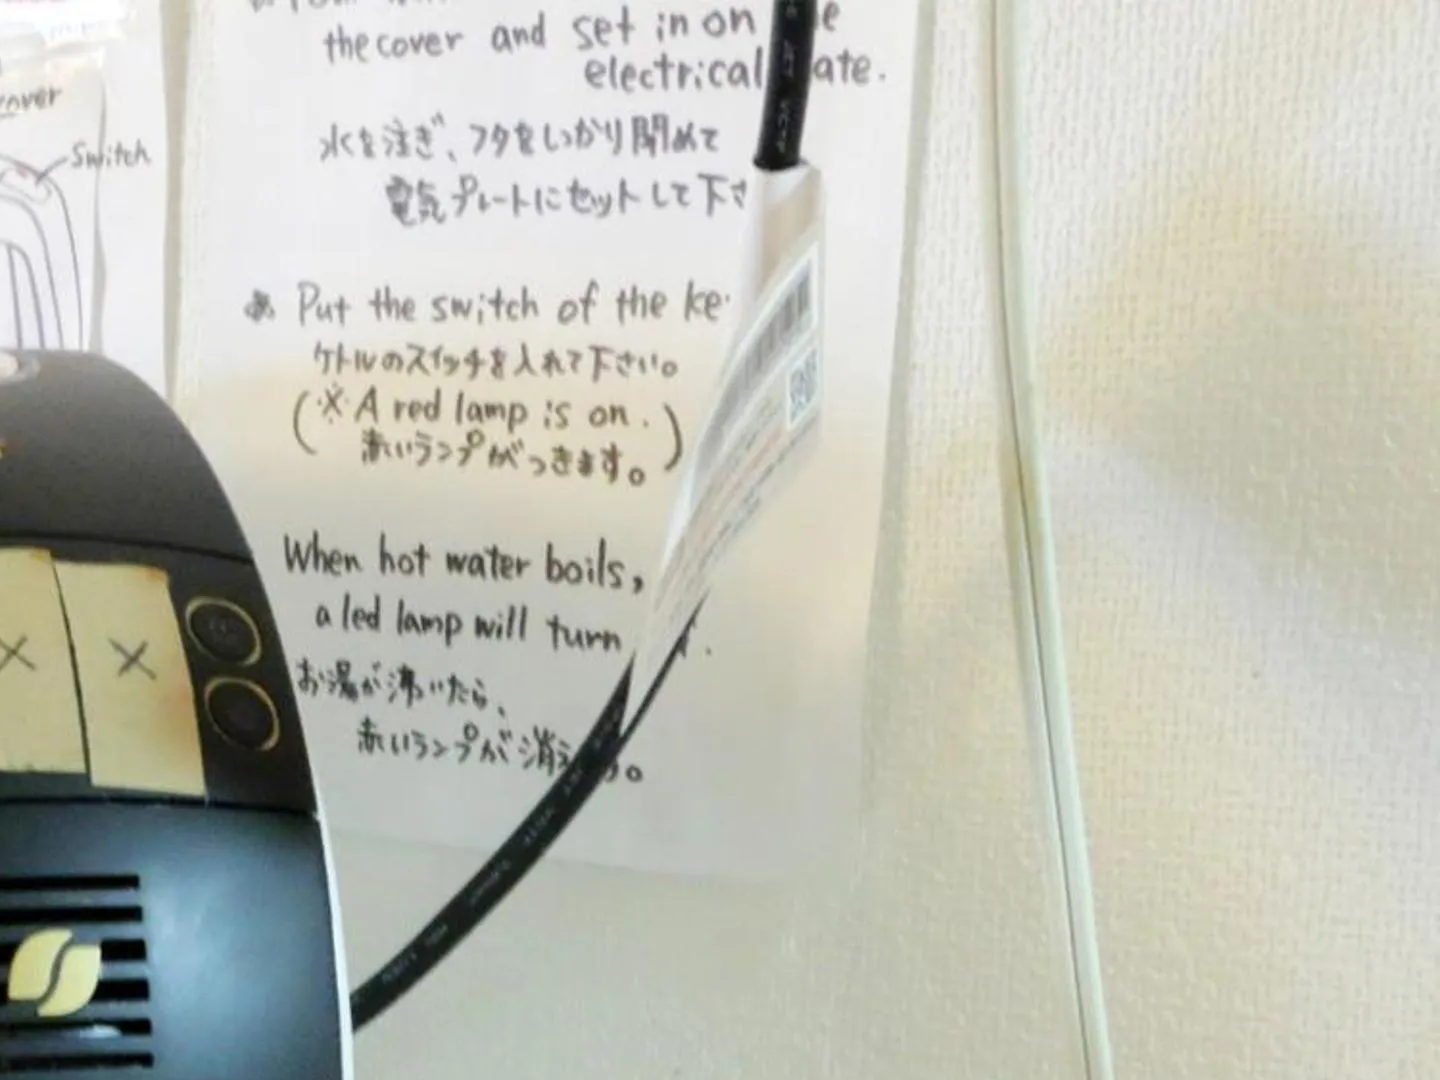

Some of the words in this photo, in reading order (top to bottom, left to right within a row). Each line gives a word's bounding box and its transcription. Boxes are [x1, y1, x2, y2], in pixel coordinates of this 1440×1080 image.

[490, 10, 546, 53] and
[571, 4, 636, 51] set
[656, 11, 689, 43] in
[702, 6, 757, 38] on
[583, 45, 764, 93] electrical
[297, 280, 352, 327] Put
[368, 283, 416, 323] the
[431, 283, 539, 326] switch
[556, 278, 600, 327] of
[615, 283, 668, 325] the
[393, 386, 442, 423] red
[454, 388, 529, 434] lamp
[543, 399, 572, 430] is
[283, 532, 361, 577] When
[378, 532, 431, 577] hot
[445, 544, 532, 581] water
[545, 536, 646, 595] boils,
[315, 603, 332, 629] a
[396, 598, 462, 648] lamp
[474, 604, 529, 642] will
[545, 612, 622, 653] turn
